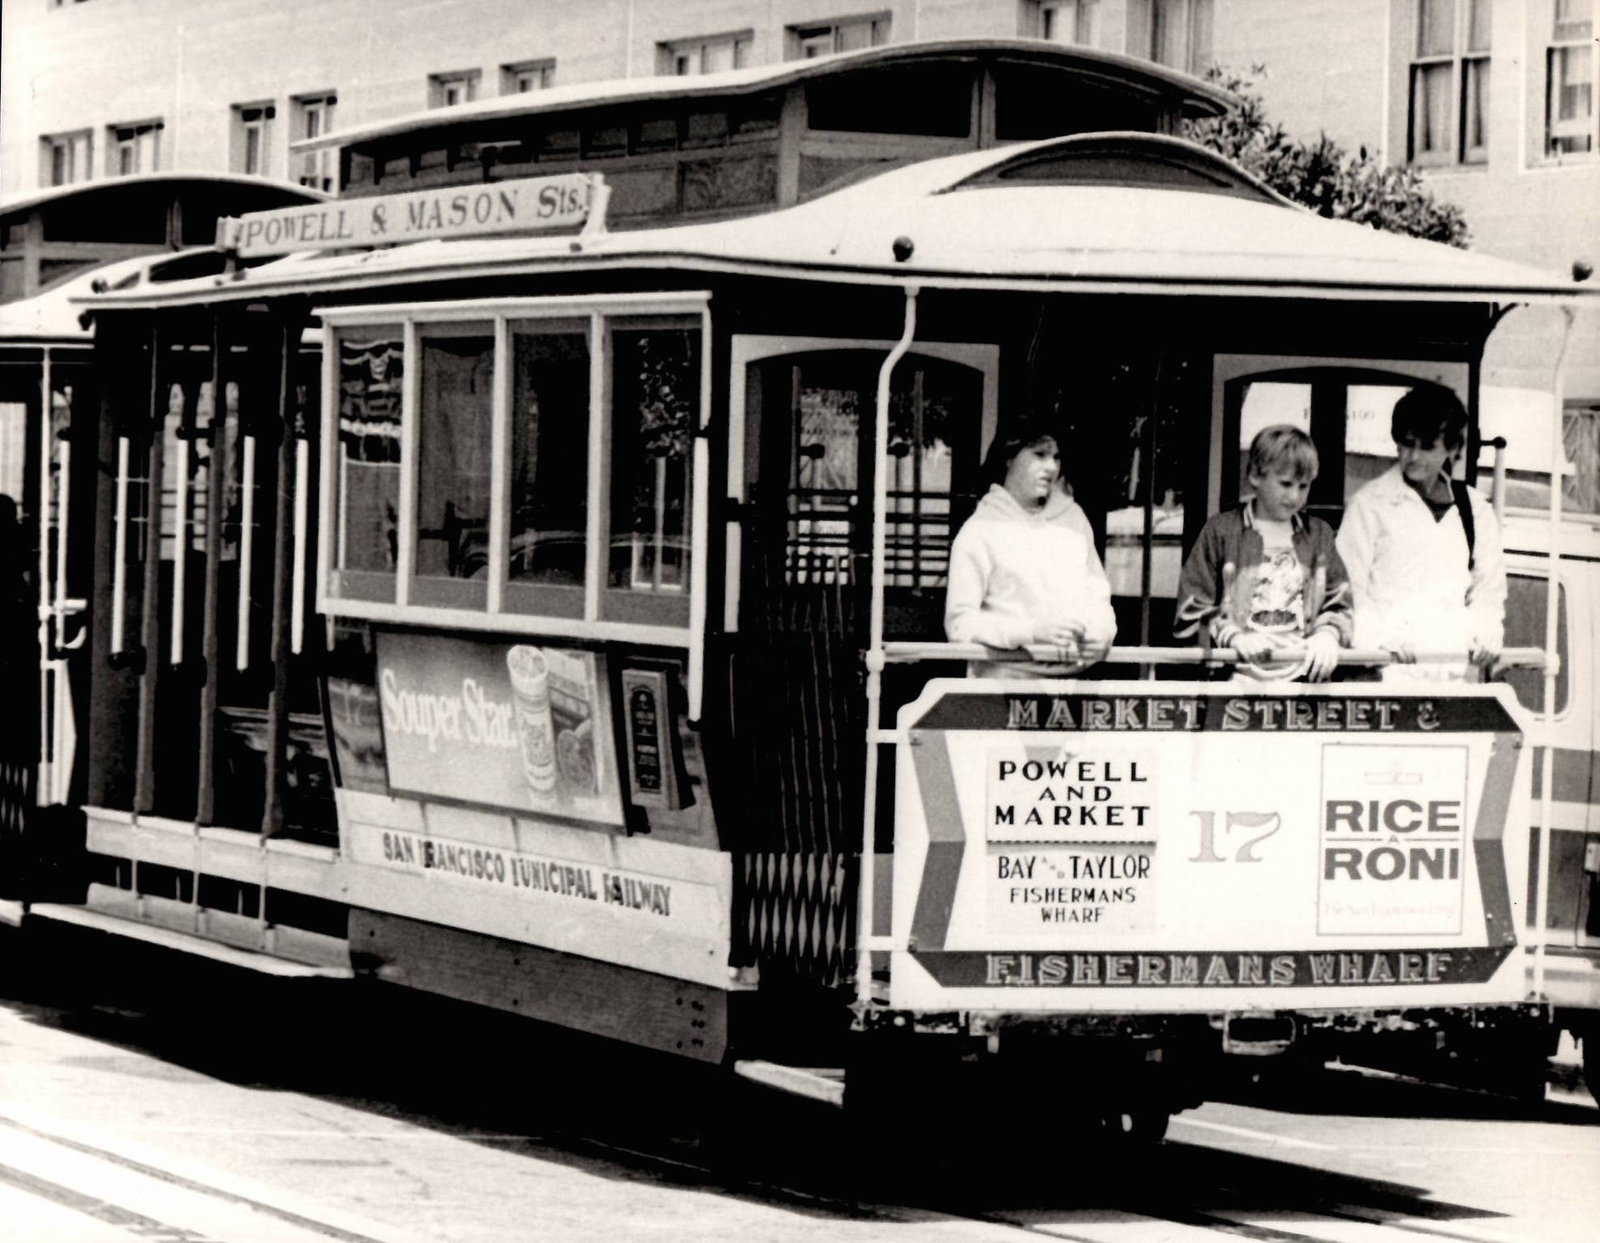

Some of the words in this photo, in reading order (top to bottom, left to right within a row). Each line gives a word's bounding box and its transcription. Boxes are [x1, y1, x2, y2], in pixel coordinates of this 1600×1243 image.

[245, 210, 354, 248] POWELL
[370, 203, 388, 236] &
[405, 189, 519, 233] MASON
[537, 183, 584, 218] Sts.
[379, 667, 465, 753] Souper
[1007, 698, 1206, 730] MARKET
[1221, 698, 1401, 731] STREET
[1416, 700, 1441, 730] &
[998, 760, 1148, 782] POWELL
[1038, 786, 1113, 802] AND
[995, 805, 1151, 826] MARKET
[1325, 799, 1461, 833] RICE
[382, 831, 416, 863] SAN
[1187, 810, 1282, 863] 17
[998, 855, 1037, 880] BAY
[1068, 854, 1151, 880] TAYLOR
[1324, 846, 1460, 881] RONI
[1010, 886, 1137, 904] FISHERMANS
[1041, 906, 1105, 924] WHARF
[985, 953, 1297, 986] FISHERMANS
[1308, 951, 1453, 984] WHARF
